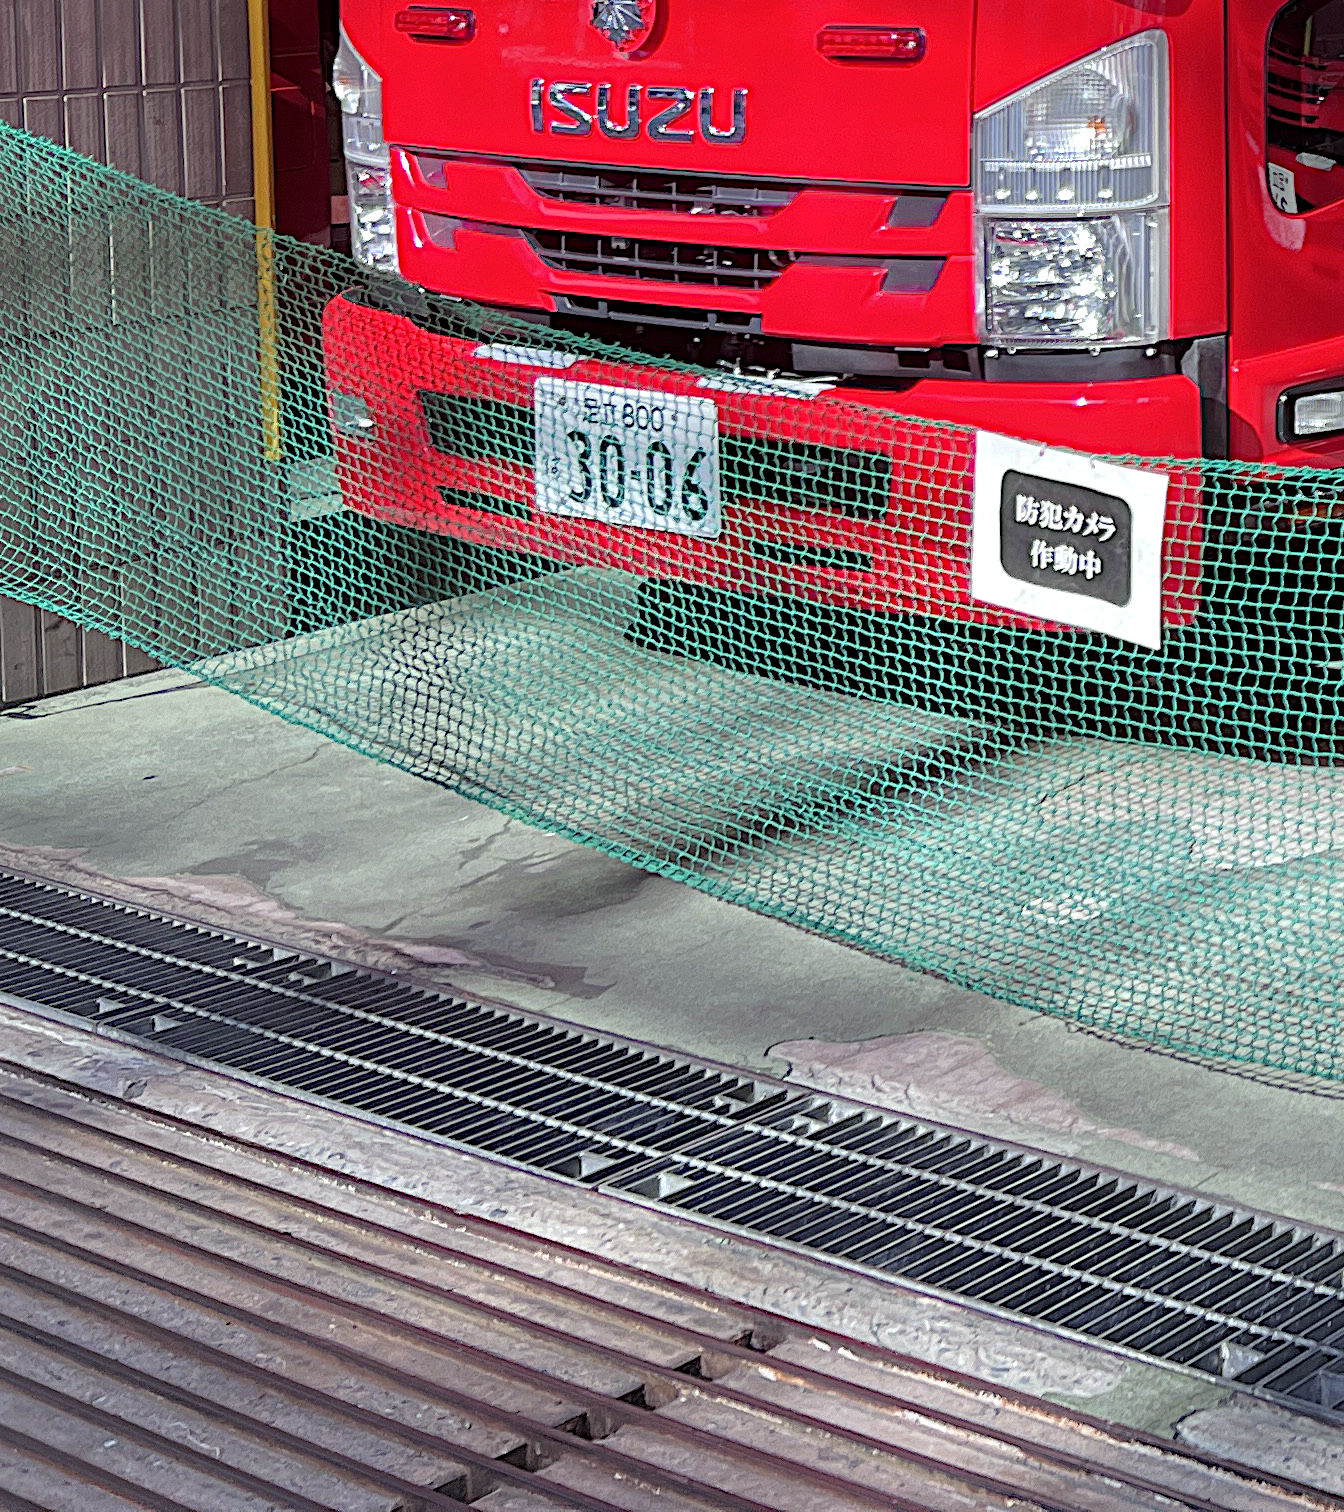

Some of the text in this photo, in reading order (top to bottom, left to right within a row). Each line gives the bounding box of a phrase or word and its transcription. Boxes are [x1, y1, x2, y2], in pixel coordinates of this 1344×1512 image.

[531, 78, 748, 146] ISUZU
[567, 430, 709, 522] 30-06
[1015, 494, 1117, 543] 防犯カメラ
[1030, 539, 1102, 580] 作動中
